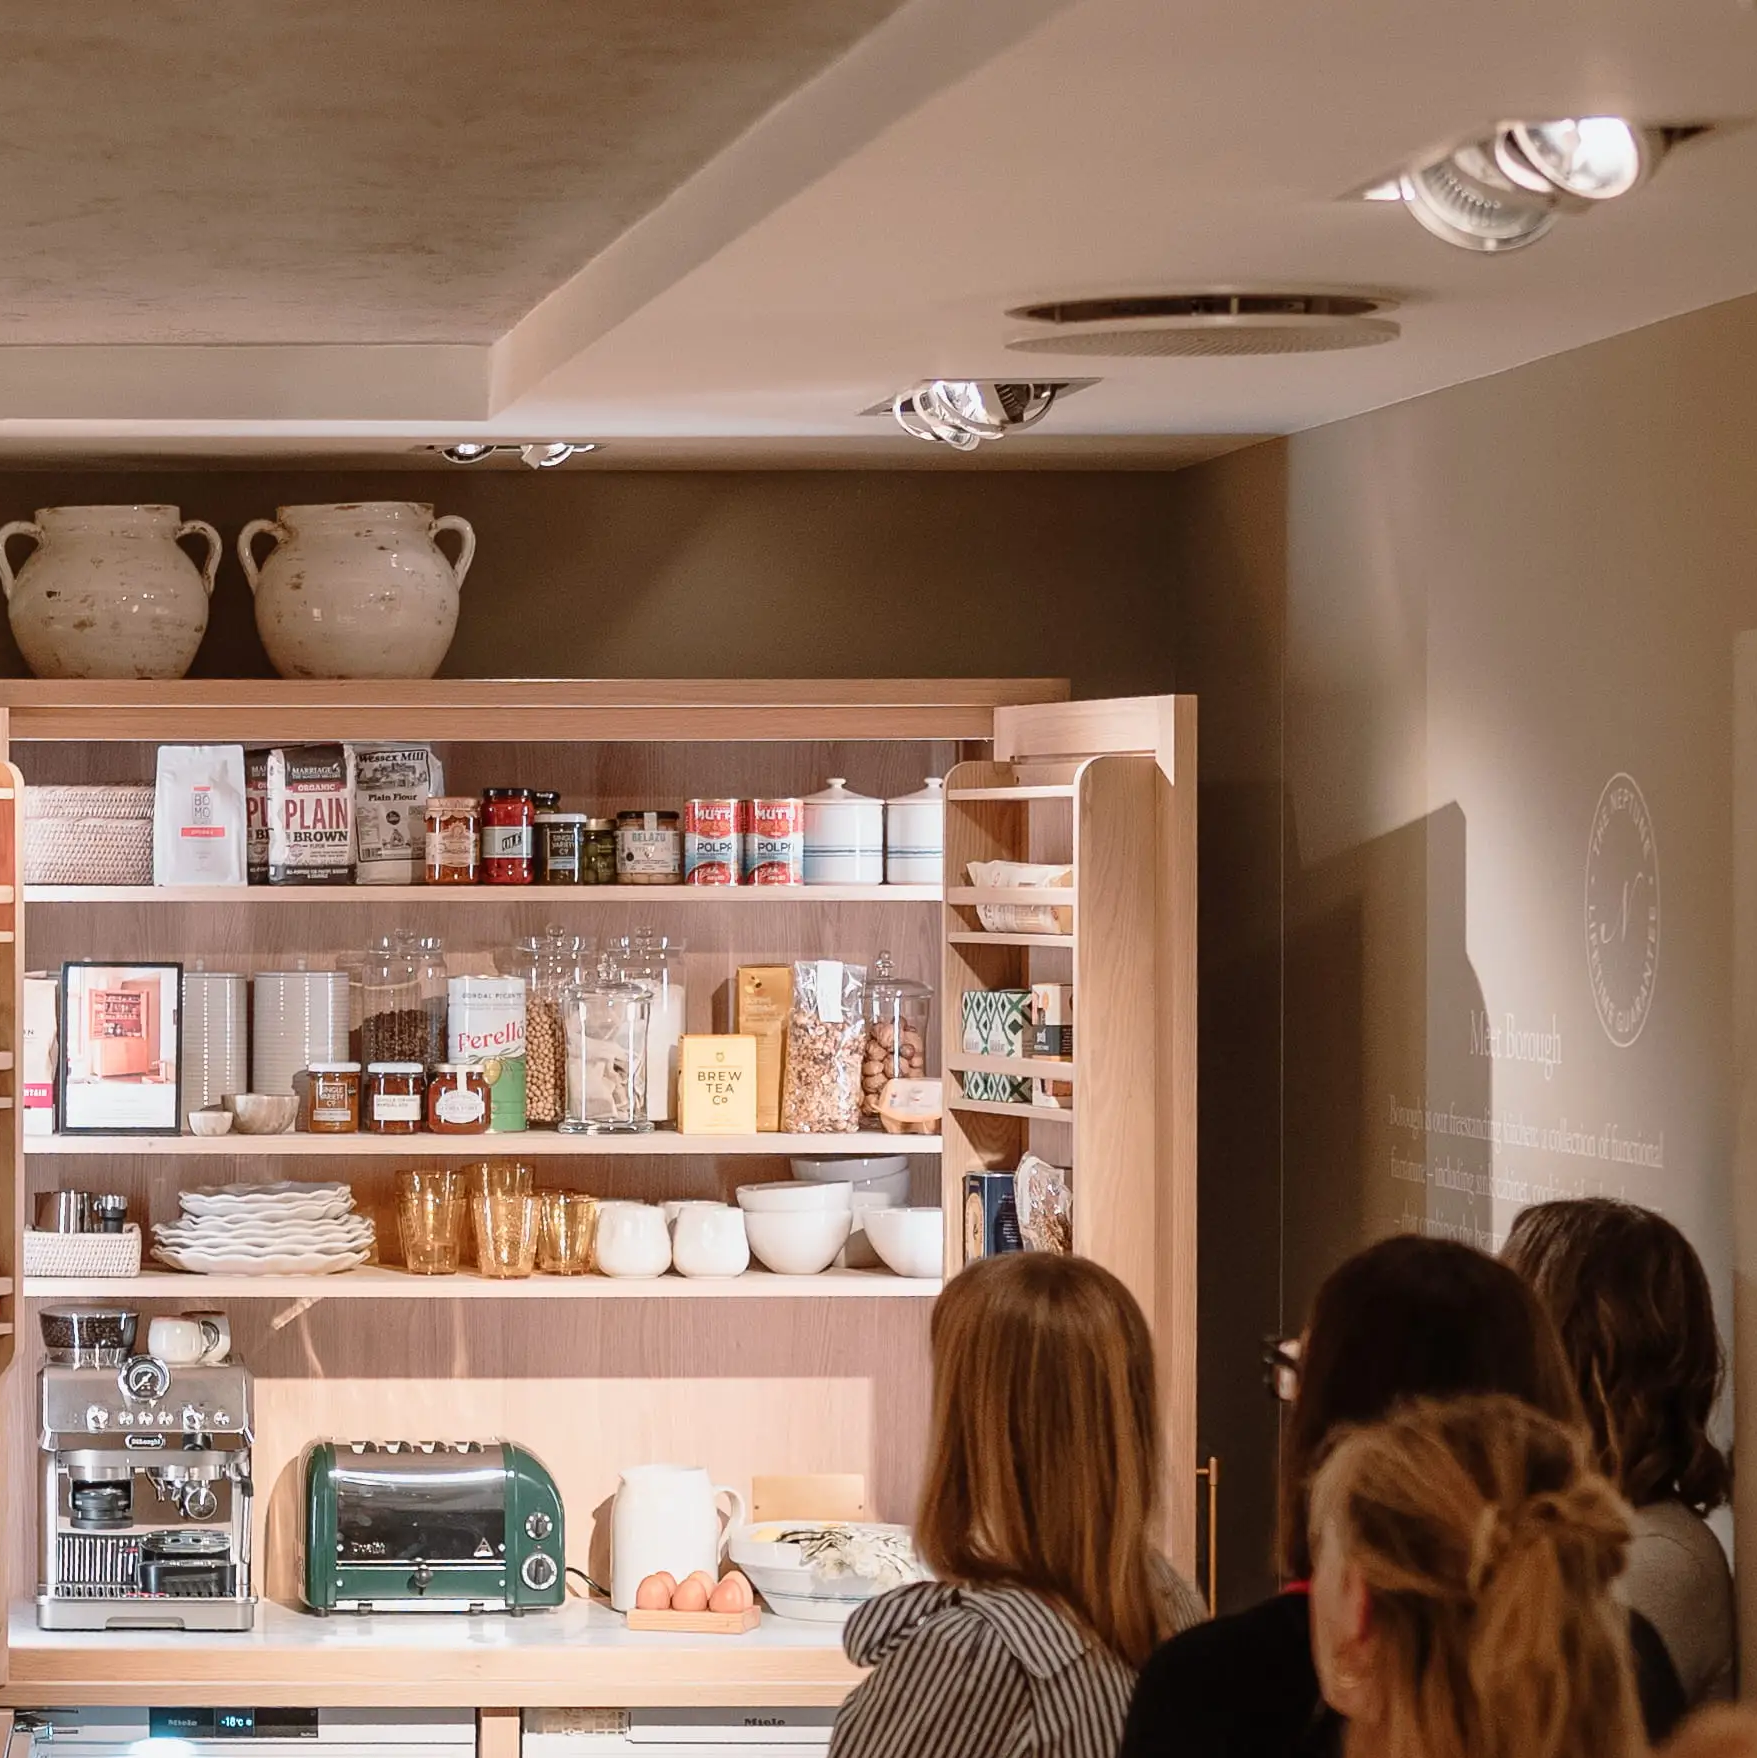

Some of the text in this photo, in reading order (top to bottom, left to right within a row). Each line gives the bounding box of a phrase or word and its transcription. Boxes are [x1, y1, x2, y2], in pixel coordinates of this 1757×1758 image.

[402, 751, 424, 761] Mill
[297, 783, 337, 792] ORGANIC
[368, 793, 418, 802] Plain Flour
[285, 797, 348, 830] PLAIN
[697, 807, 735, 820] MUTT
[756, 807, 795, 820] MUTT
[293, 830, 349, 842] BROWN
[632, 832, 666, 842] BELAZU
[1504, 1012, 1562, 1080] Borough
[697, 1071, 742, 1082] BREW
[706, 1083, 734, 1094] TEA
[712, 1095, 728, 1106] Co
[744, 1717, 786, 1726] Miele
